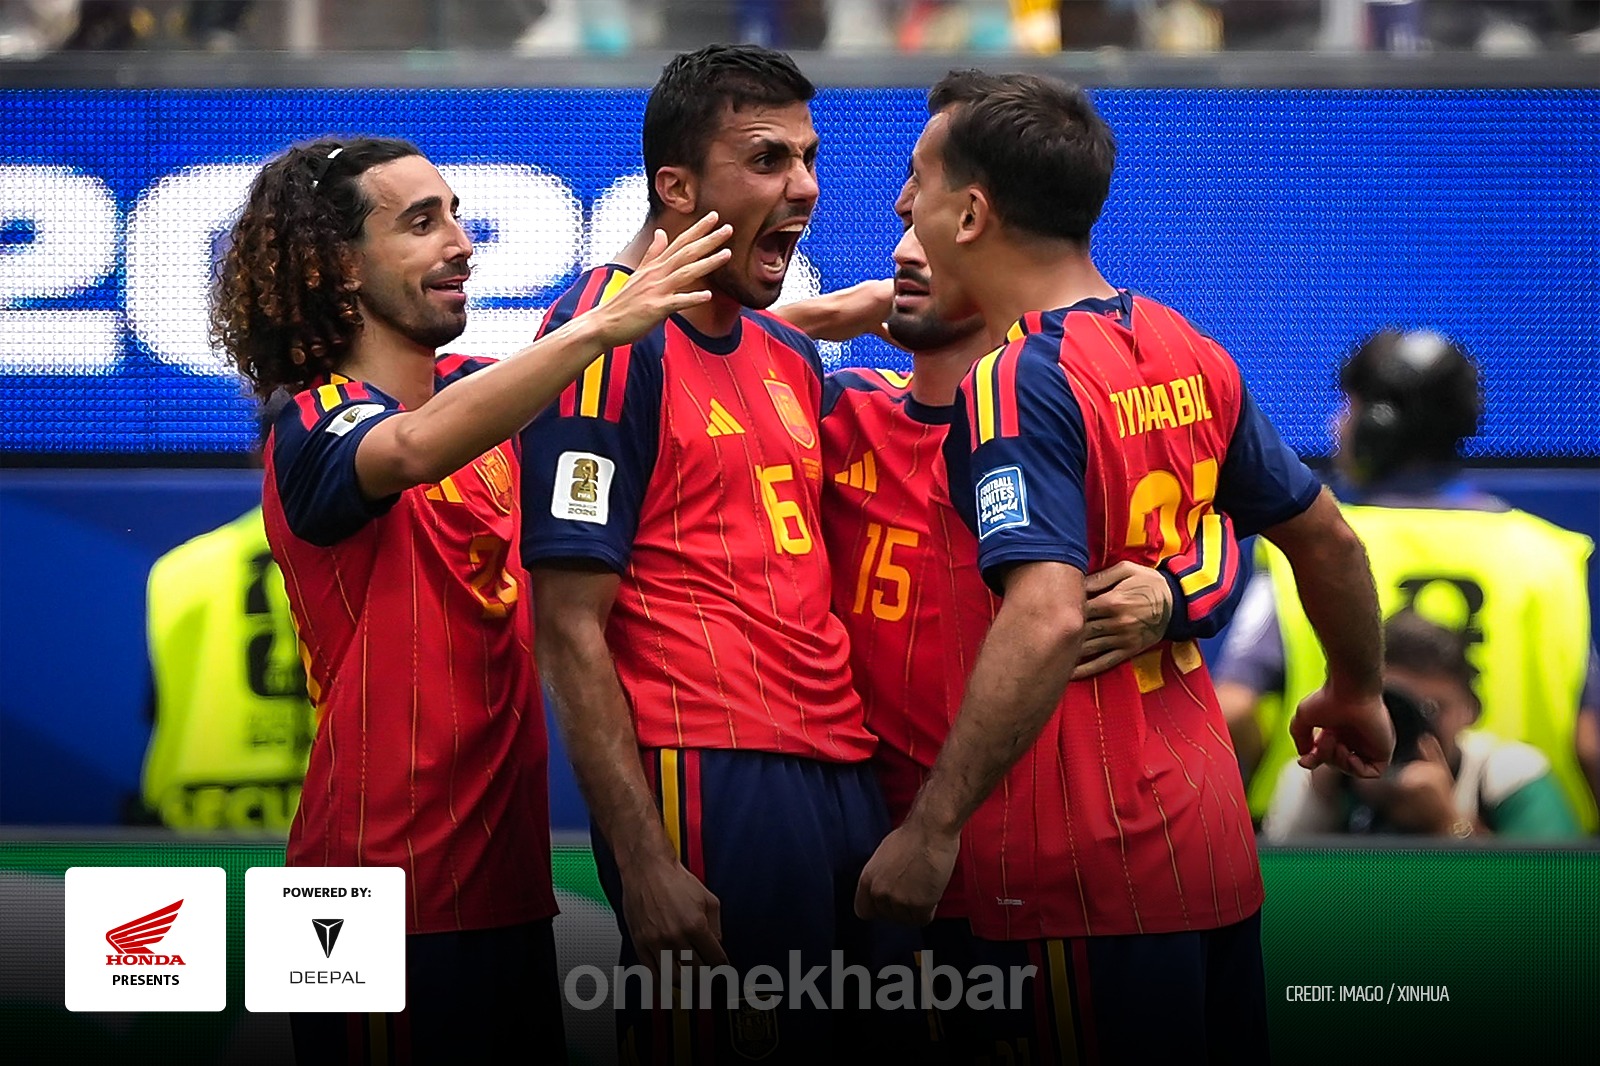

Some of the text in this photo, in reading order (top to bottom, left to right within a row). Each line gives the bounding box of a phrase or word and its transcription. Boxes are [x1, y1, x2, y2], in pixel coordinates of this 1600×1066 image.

[755, 465, 812, 555] 16
[980, 476, 1014, 496] FOOTBALL
[980, 486, 1015, 511] UNITES
[853, 523, 922, 622] 15
